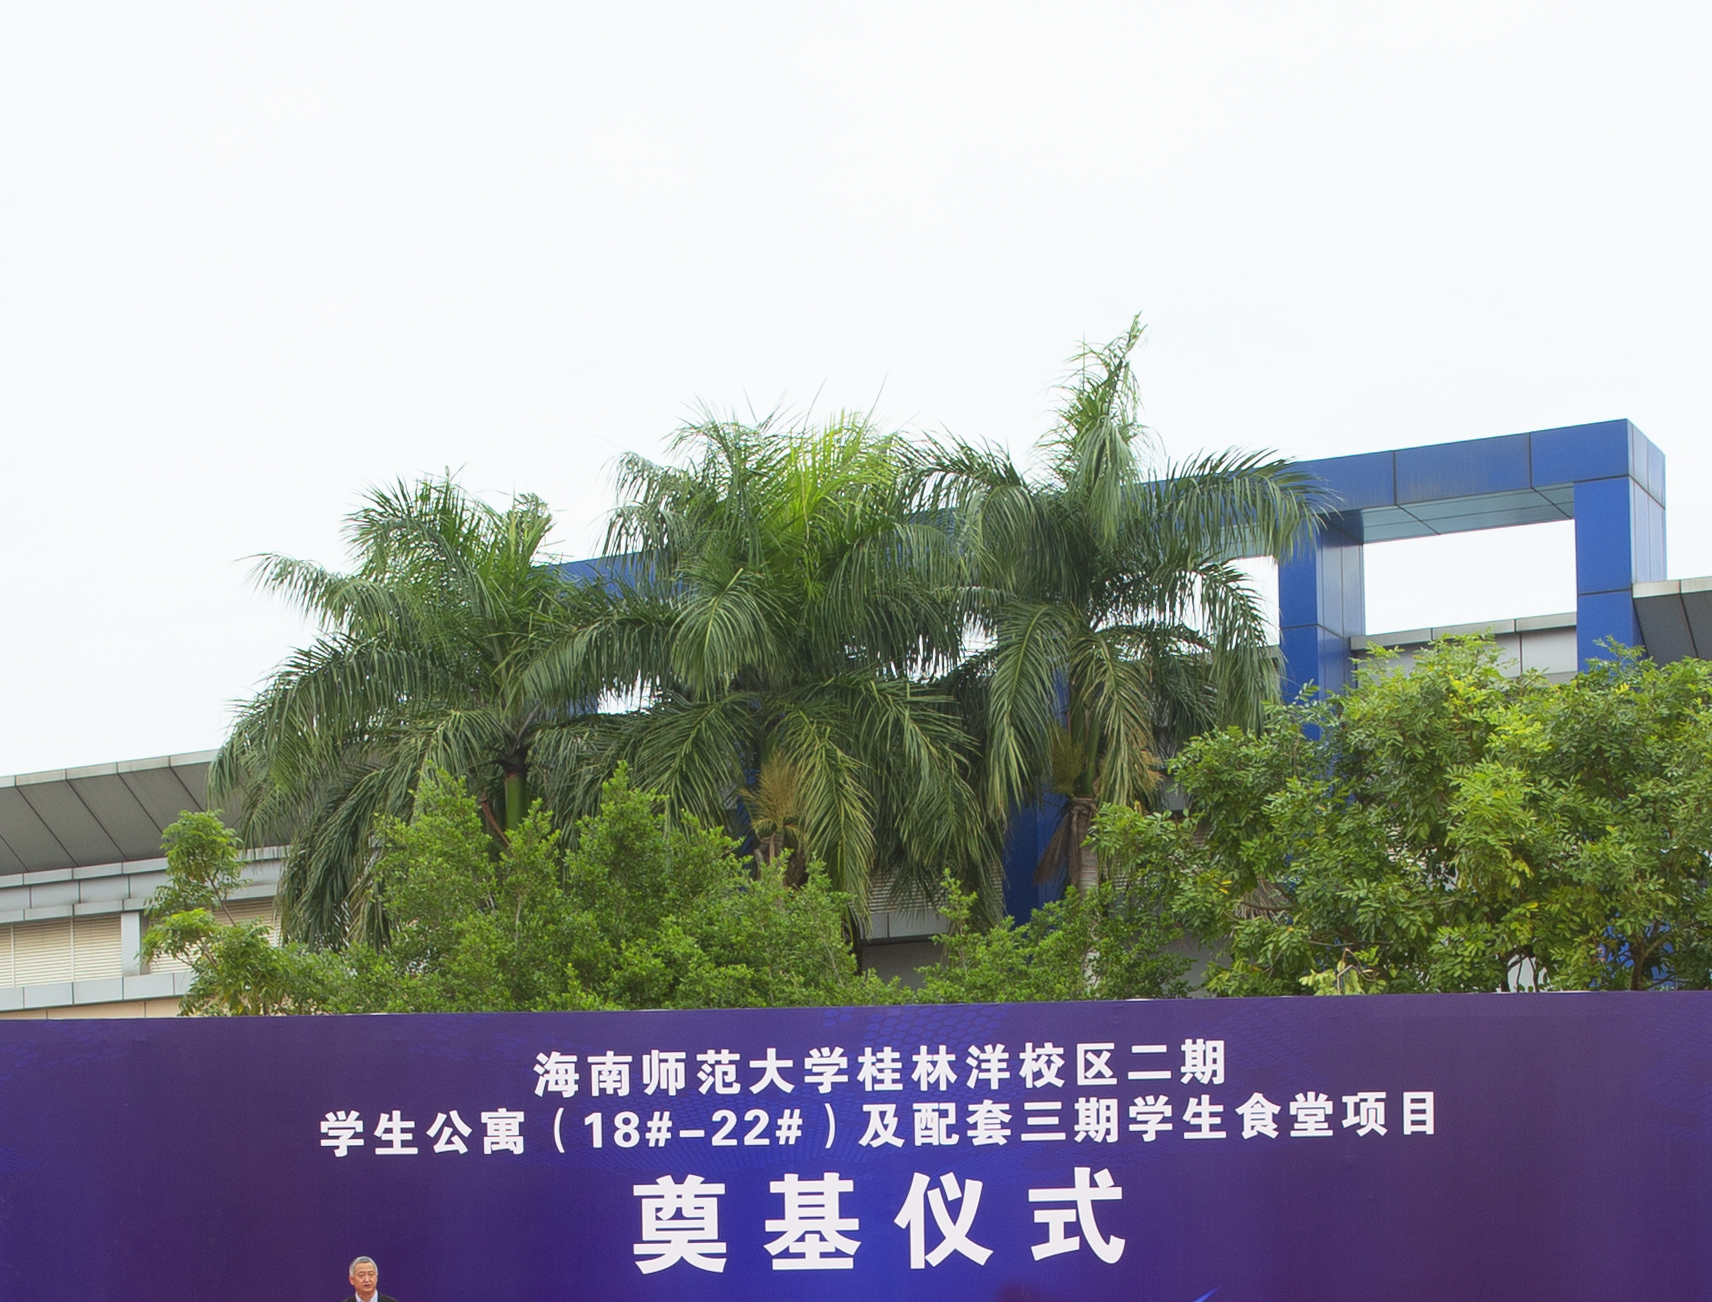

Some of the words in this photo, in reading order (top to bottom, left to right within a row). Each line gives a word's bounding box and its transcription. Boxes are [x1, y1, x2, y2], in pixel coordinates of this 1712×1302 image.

[533, 1038, 1226, 1098] 海南师范大学桂林洋校区二期
[632, 1167, 1126, 1275] 奠基仪式
